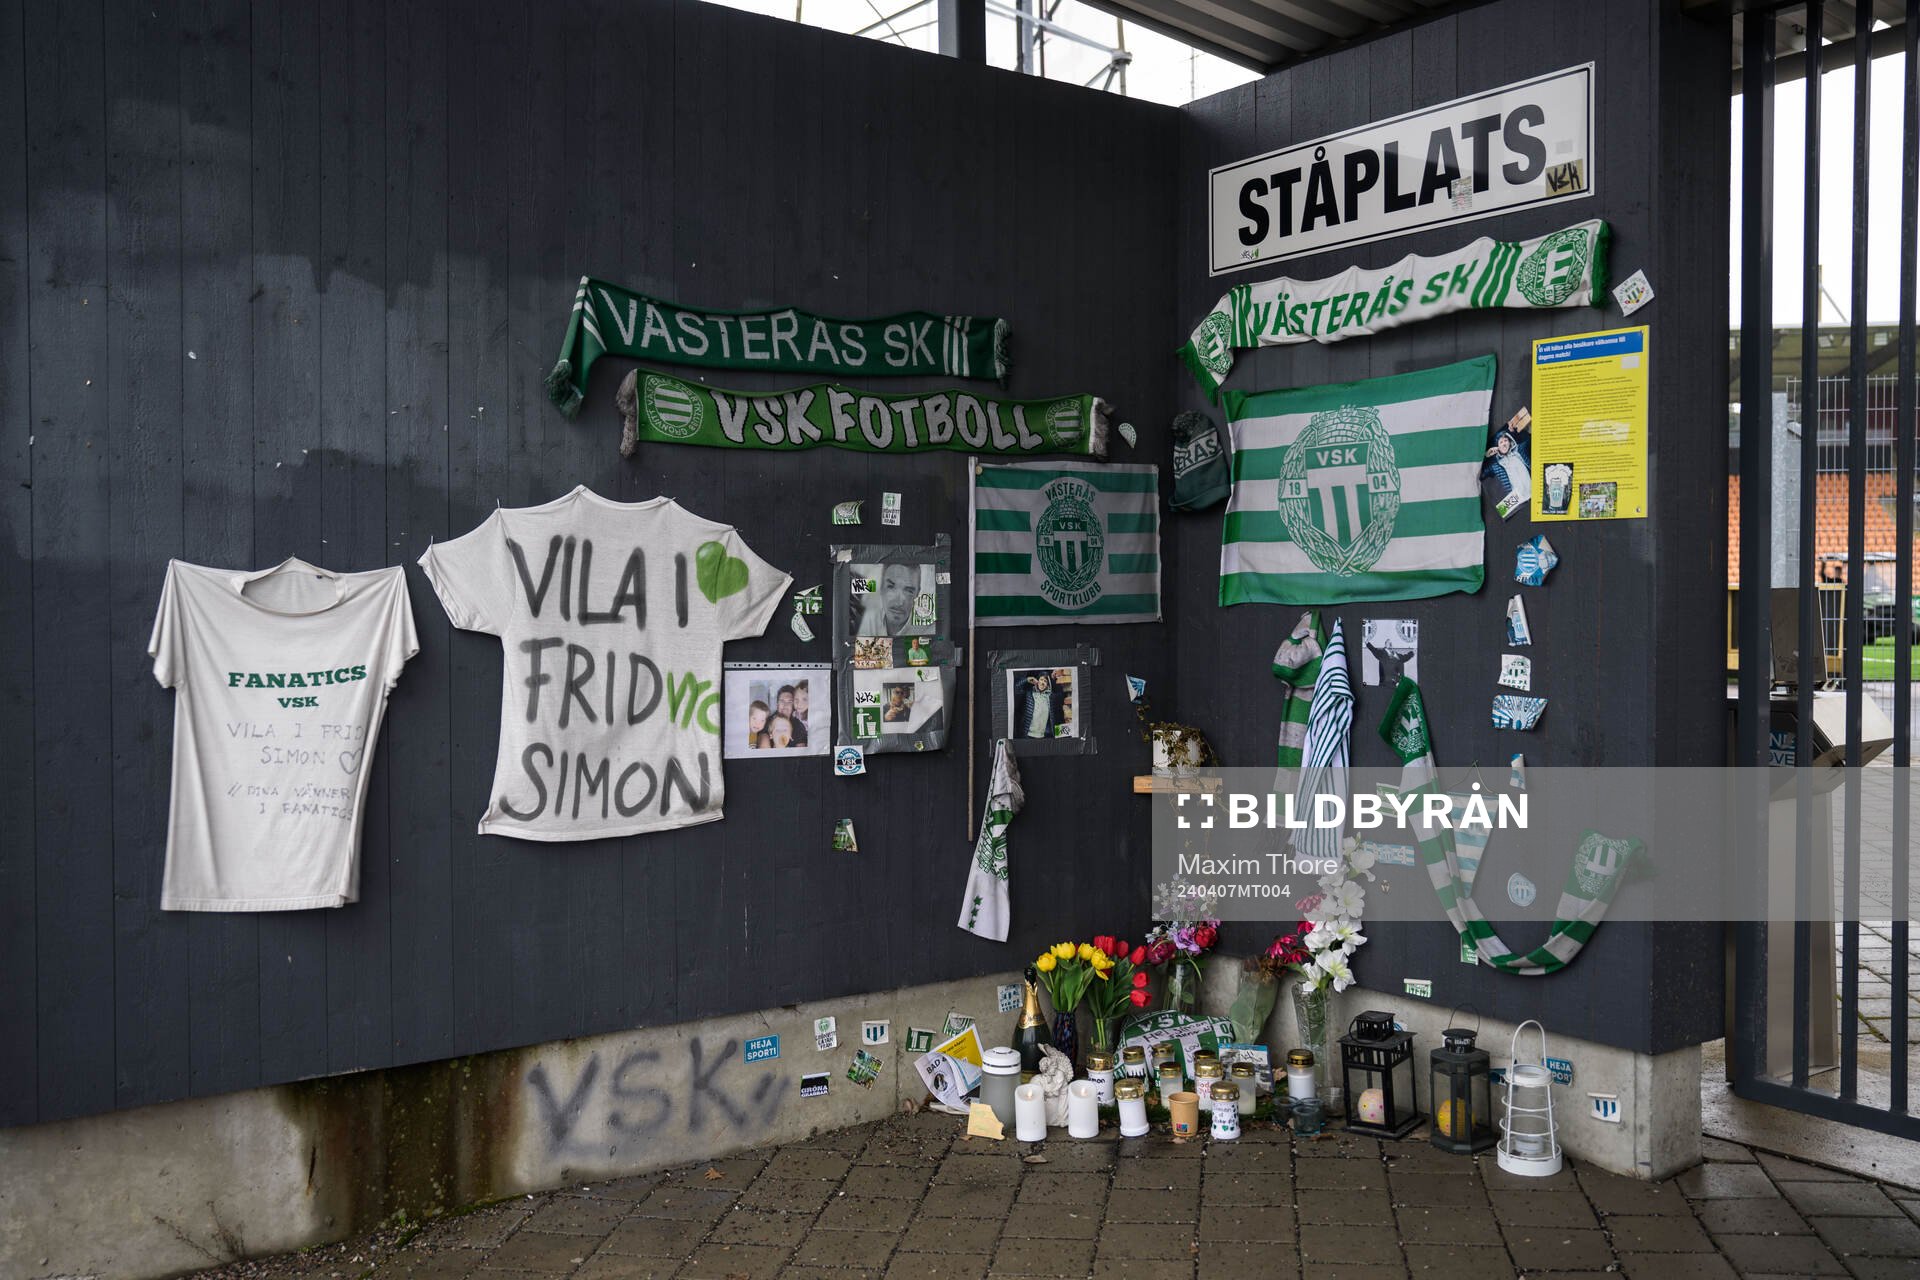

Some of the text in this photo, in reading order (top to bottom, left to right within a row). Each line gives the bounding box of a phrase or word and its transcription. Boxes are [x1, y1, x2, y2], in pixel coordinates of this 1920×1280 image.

[1238, 104, 1546, 246] STÅPLATS
[1547, 162, 1581, 192] VSK
[1252, 259, 1480, 336] VÄSTERÅS SK
[883, 320, 936, 367] SK
[709, 388, 823, 446] VSK
[826, 386, 1044, 450] FOTBOLL
[1316, 447, 1358, 466] VSK
[1045, 482, 1096, 503] VÄSTERÅS
[1288, 482, 1301, 496] 19
[1373, 476, 1387, 490] 04
[1059, 521, 1081, 530] VSK
[506, 534, 689, 630] VILA I
[1041, 579, 1102, 606] SPORTKLUBB
[228, 665, 368, 688] FANATICS
[519, 637, 664, 729] FRID
[277, 696, 319, 709] VSK
[227, 722, 365, 741] VILA I FRID
[260, 745, 326, 765] SIMON
[294, 783, 351, 799] VÄNNER
[500, 742, 711, 822] SIMON
[1138, 1014, 1195, 1032] VSK
[747, 1047, 777, 1060] SPORTI
[750, 1039, 772, 1049] HEJA
[926, 1060, 941, 1074] BAD
[1549, 1061, 1572, 1073] HEJA
[527, 1037, 747, 1152] VSK
[801, 1084, 828, 1094] GRÖNA
